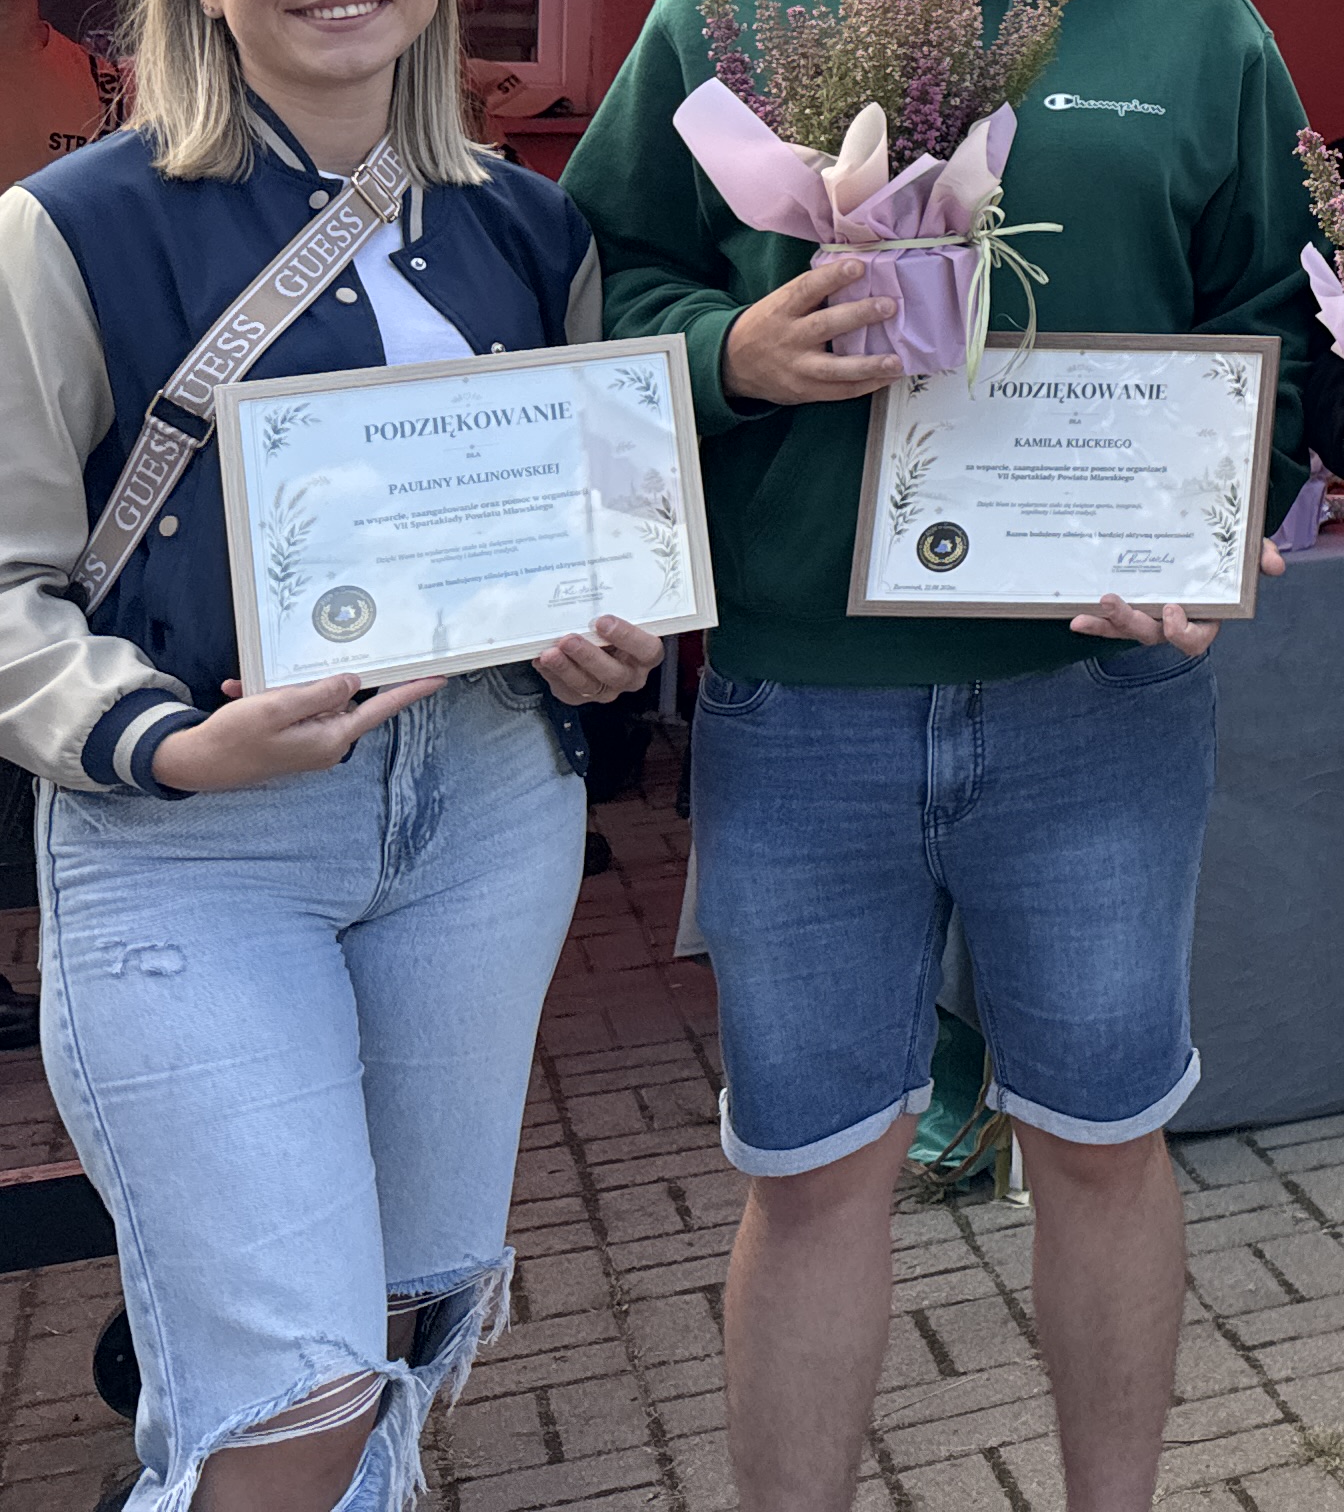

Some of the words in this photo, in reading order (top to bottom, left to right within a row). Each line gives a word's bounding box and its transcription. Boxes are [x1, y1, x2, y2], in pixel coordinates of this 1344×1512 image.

[274, 204, 367, 300] GUESS
[175, 311, 268, 406] UESS
[988, 379, 1167, 403] PODZIĘKOWANIE
[363, 400, 572, 443] PODZIĘKOWANIE
[1013, 437, 1063, 448] KAMILA
[1065, 437, 1132, 449] KLICKIEGO
[114, 431, 182, 534] GUES
[387, 476, 452, 495] PAULINY
[455, 462, 559, 486] KALINOWSKIEJ
